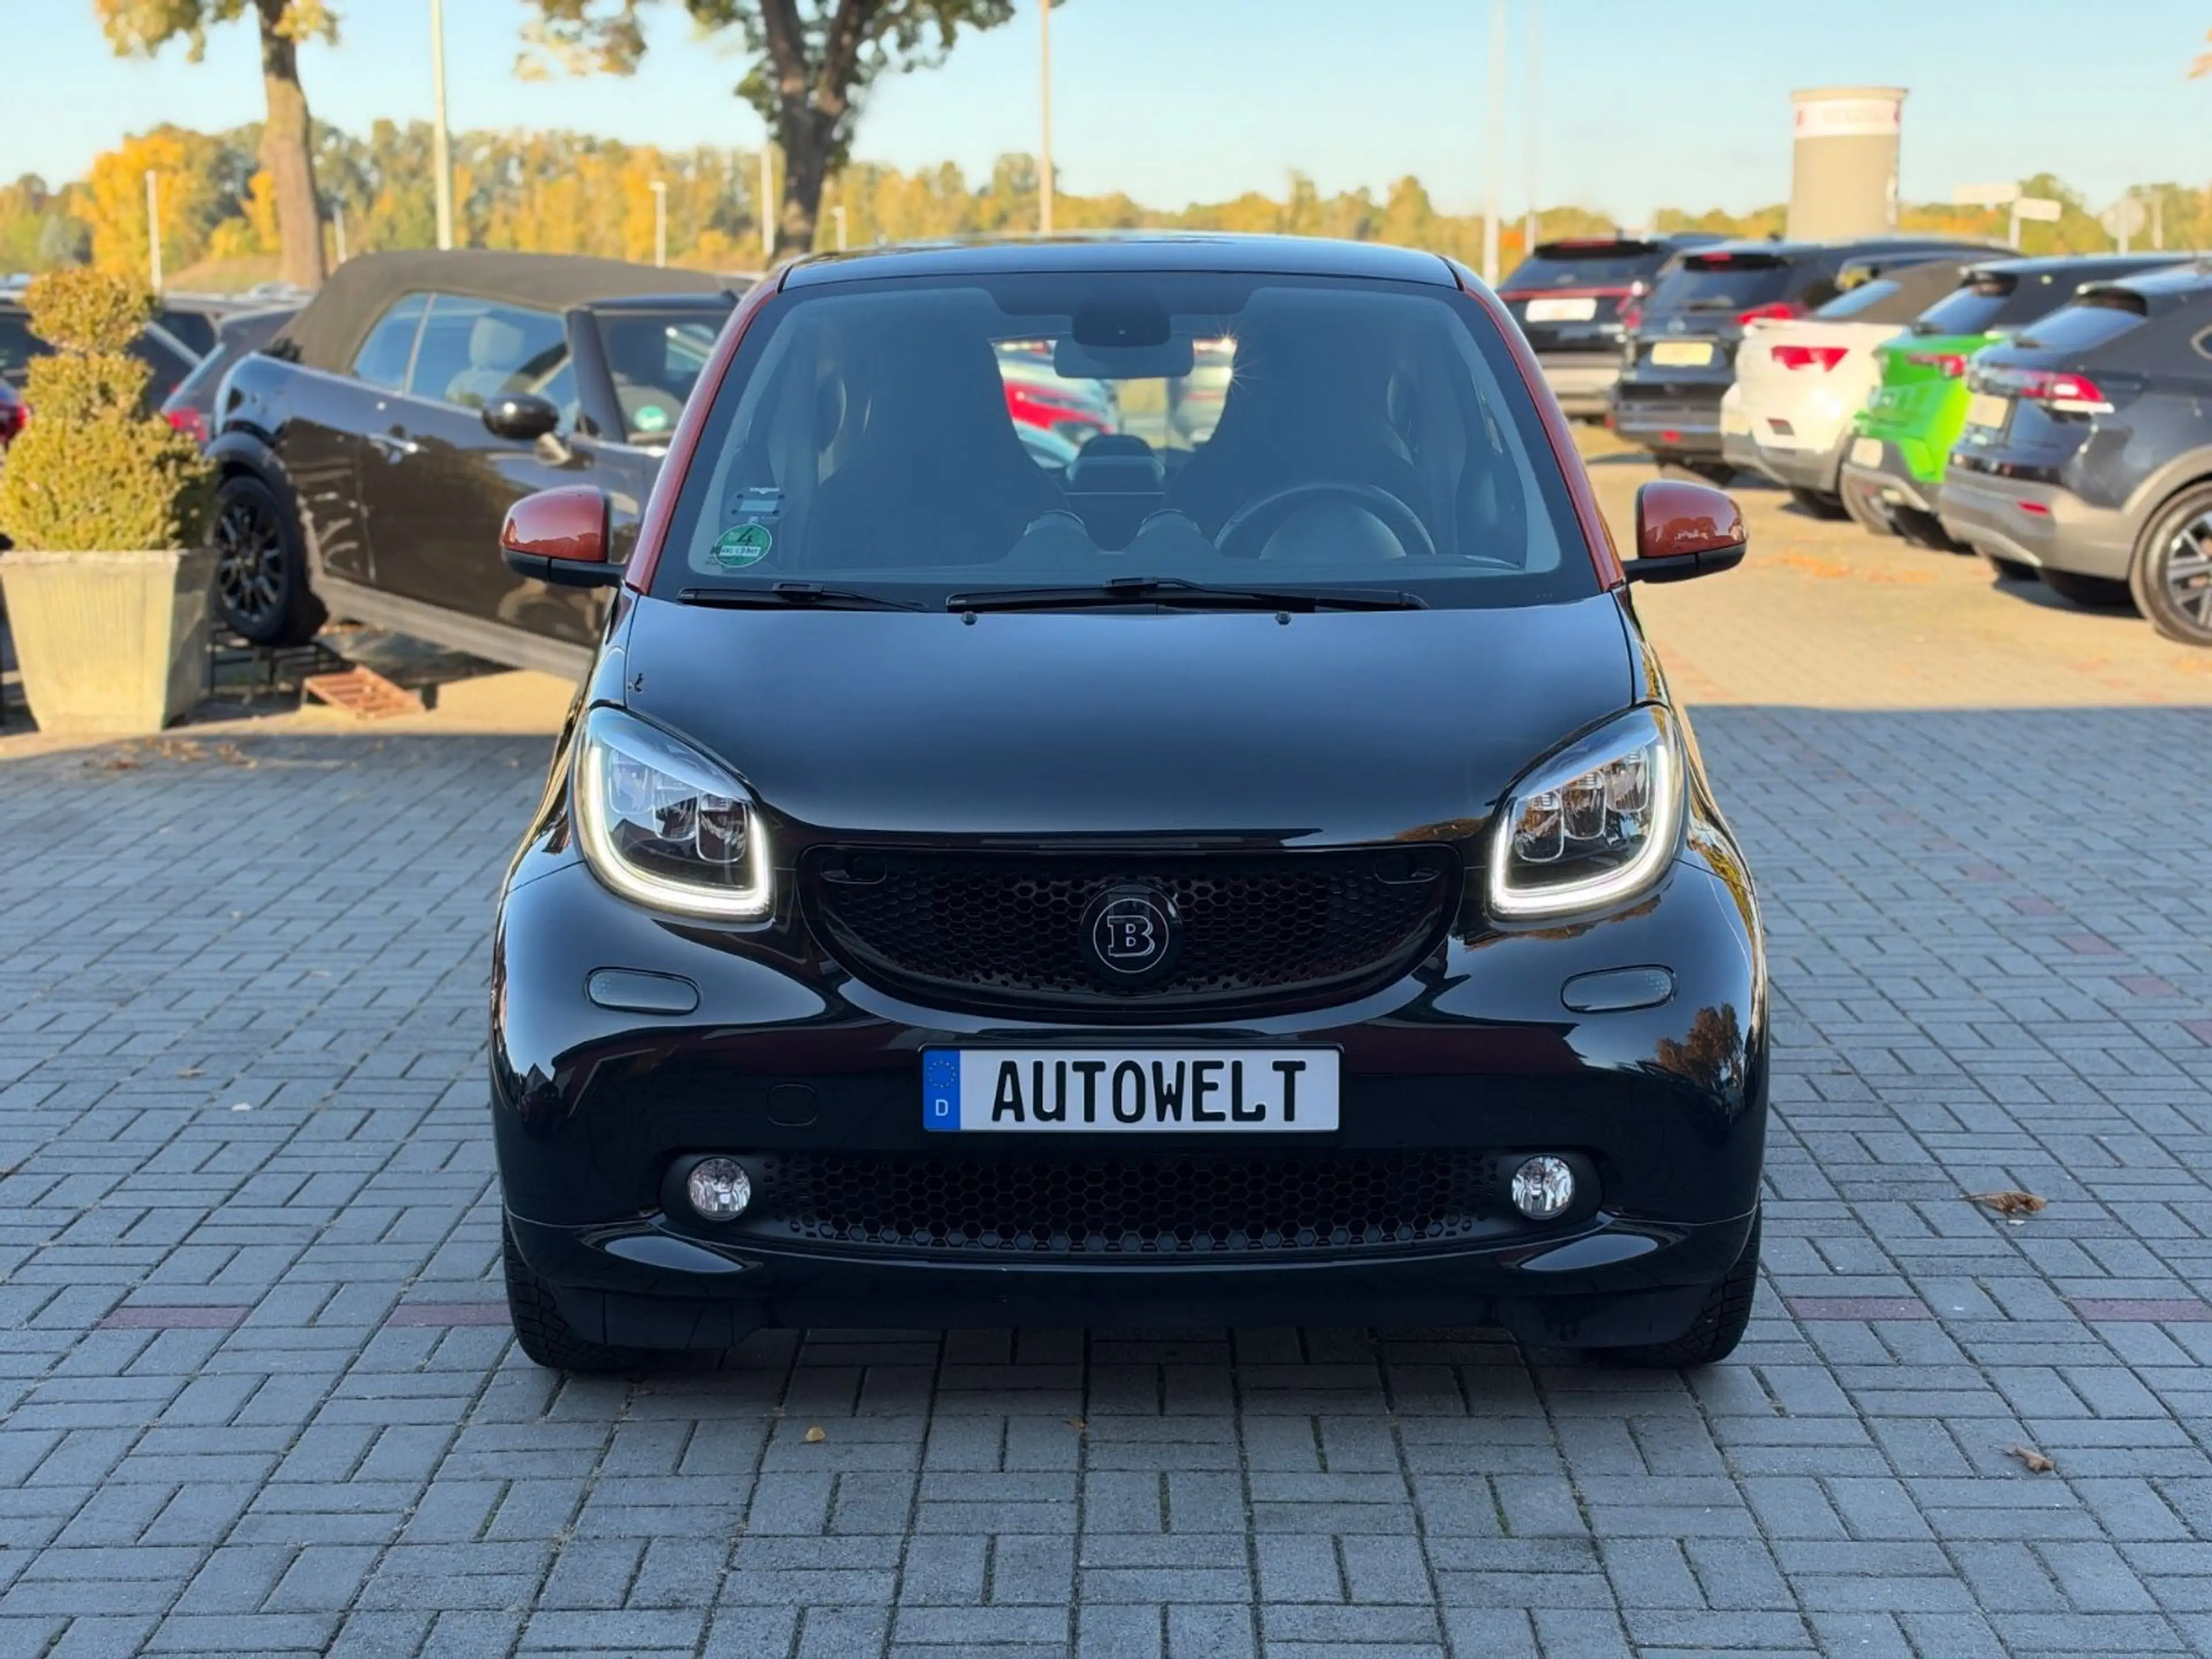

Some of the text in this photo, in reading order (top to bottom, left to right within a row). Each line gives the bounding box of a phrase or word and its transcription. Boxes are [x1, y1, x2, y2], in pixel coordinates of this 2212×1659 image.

[736, 527, 754, 547] 4
[1107, 915, 1156, 957] B
[991, 1060, 1306, 1123] AUTOWELT
[935, 1099, 949, 1117] D
